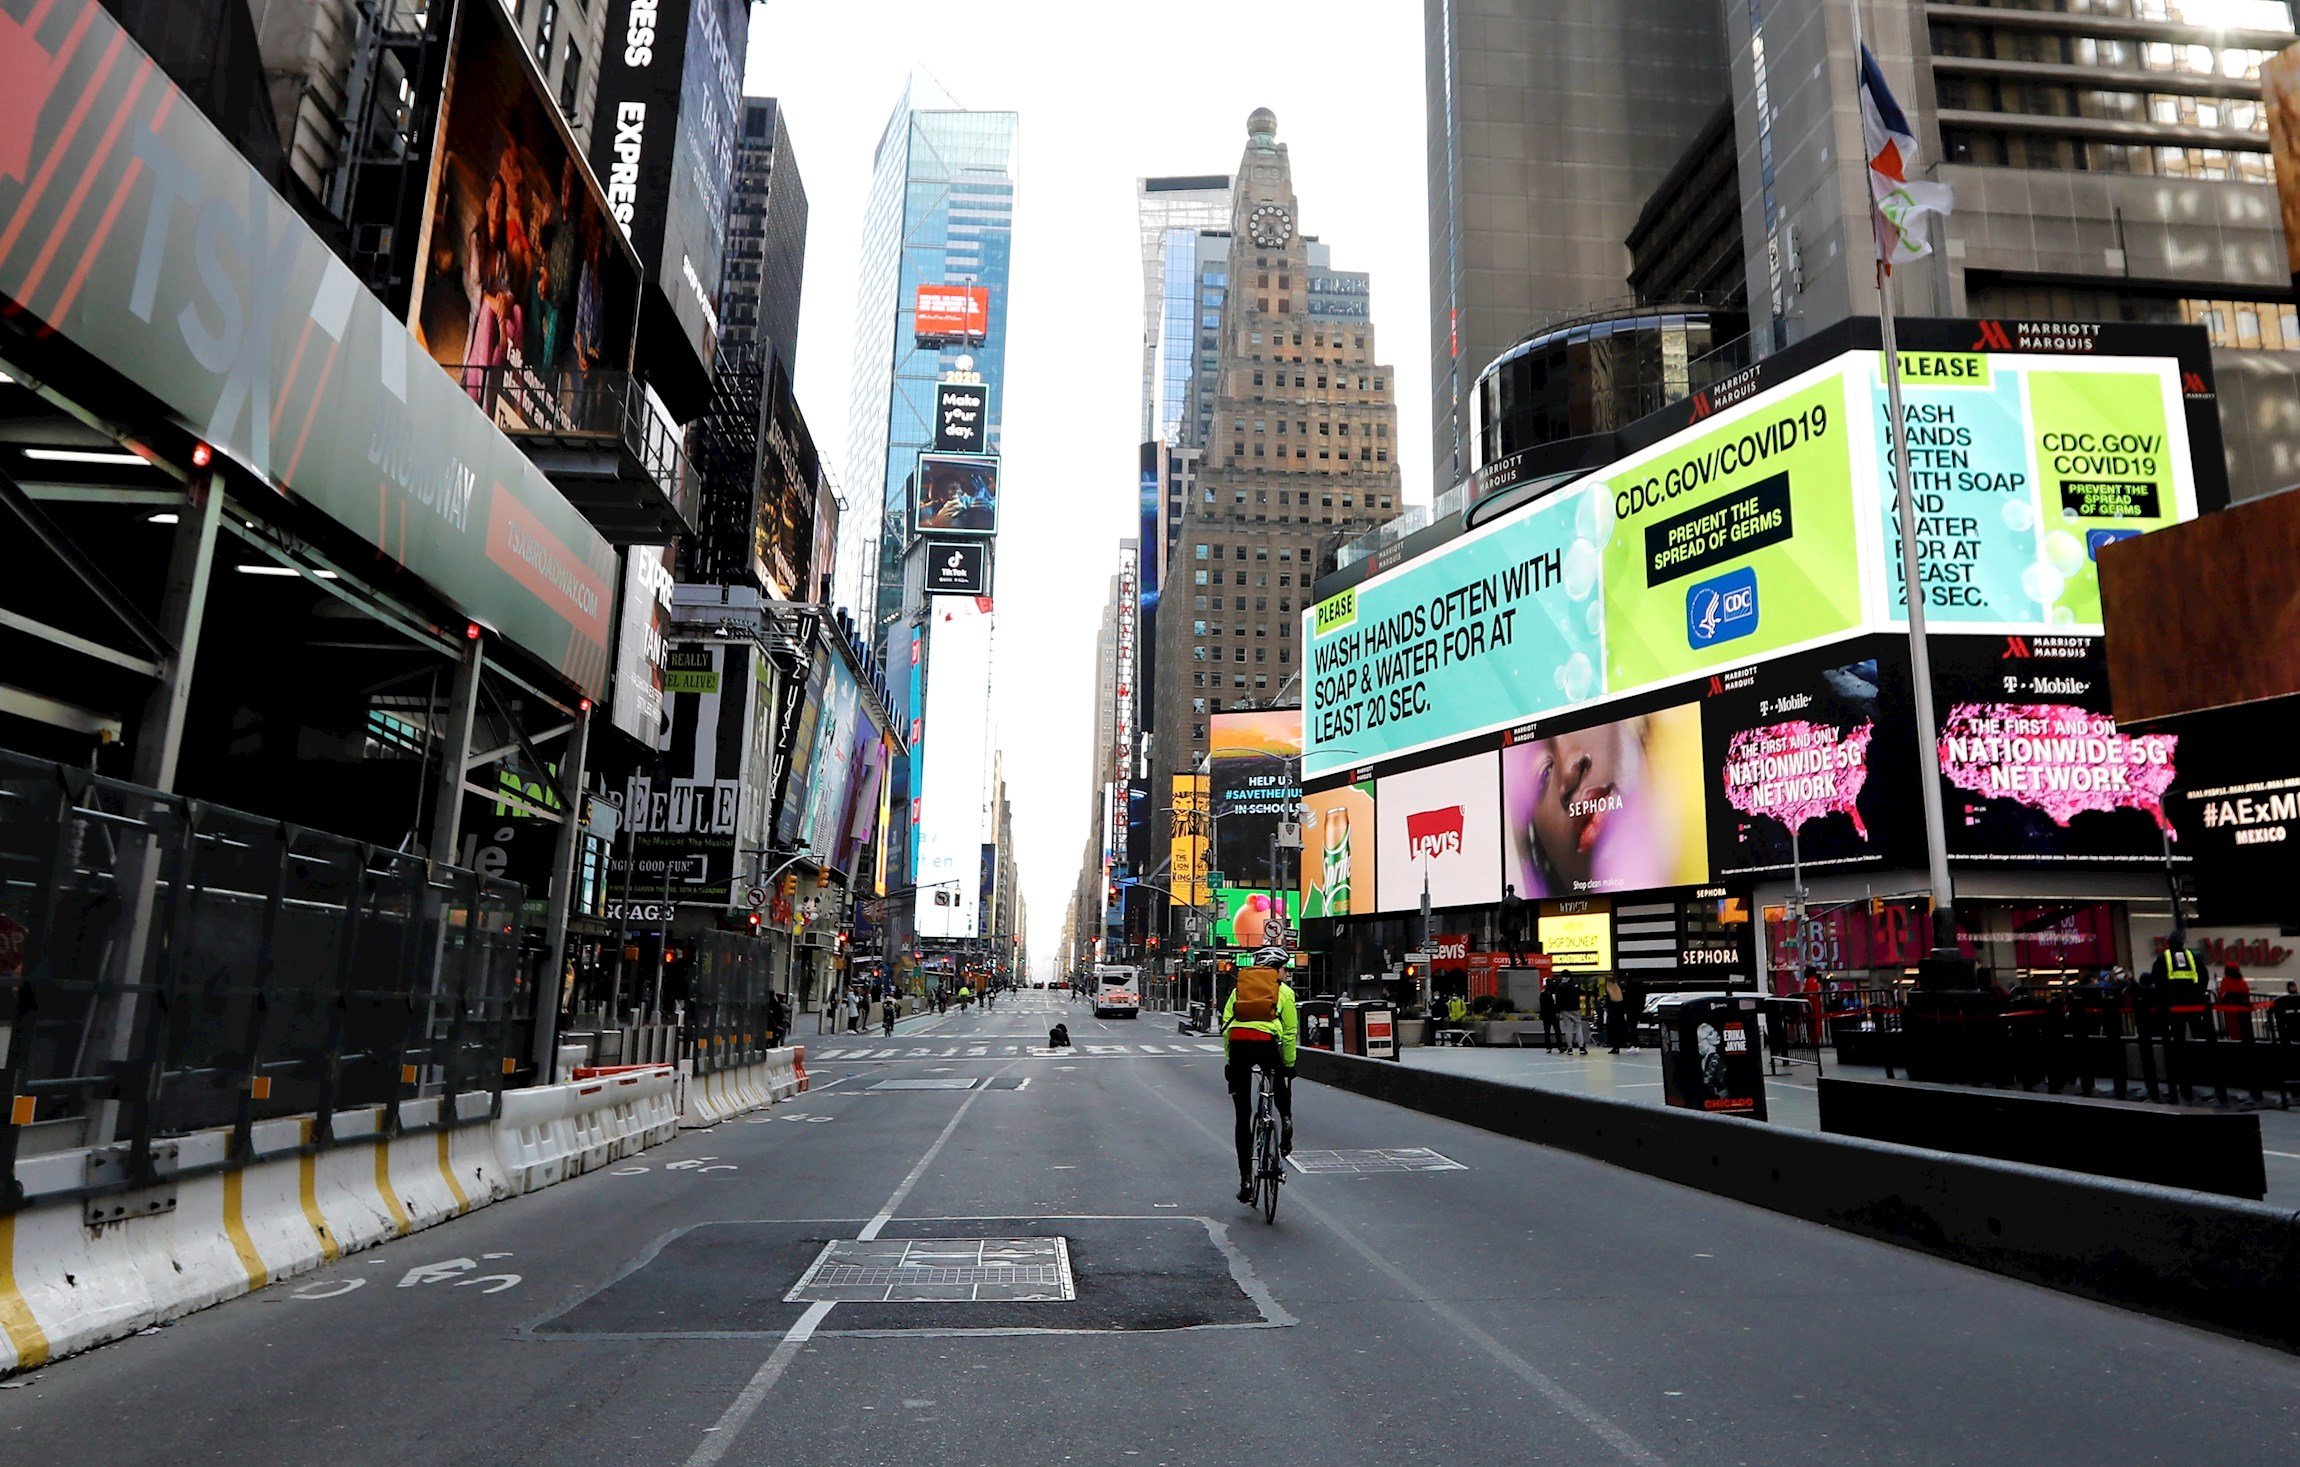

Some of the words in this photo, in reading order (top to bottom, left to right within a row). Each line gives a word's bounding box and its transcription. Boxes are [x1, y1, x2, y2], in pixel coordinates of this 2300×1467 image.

[2018, 323, 2100, 336] MARRIOTT
[2019, 337, 2093, 350] MARQUIS
[1713, 365, 1762, 395] MARRIOTT
[942, 392, 980, 407] Make
[1714, 382, 1757, 409] MARQUIS
[944, 408, 976, 424] your
[945, 423, 974, 440] day.
[2042, 434, 2162, 455] CDC.GOV/
[1479, 454, 1523, 481] MARRIOTT
[1615, 404, 1827, 519] CDC.GOV/COVID19
[2054, 456, 2157, 476] COVID19
[1479, 470, 1517, 494] MARQUIS
[1958, 472, 2025, 492] SOAP
[2068, 484, 2123, 495] PREVENT
[2125, 485, 2148, 495] THE
[2084, 494, 2131, 505] SPREAD
[2080, 504, 2096, 515] OF
[2099, 504, 2141, 515] GERMS
[1668, 509, 1727, 547] PREVENT
[1730, 496, 1759, 521] THE
[1654, 539, 1705, 571] SPREAD
[1708, 531, 1727, 551] OF
[1730, 508, 1782, 540] GERMS
[1952, 541, 1982, 560] AT
[942, 568, 967, 577] TikTok
[1725, 590, 1751, 613] CDC
[1932, 587, 1989, 607] SEC.
[1314, 631, 1360, 675] WASH
[1365, 605, 1426, 652] HANDS
[1430, 575, 1497, 631] OFTEN
[1502, 548, 1562, 603] WITH
[1318, 594, 1352, 626] PLEASE
[2033, 637, 2091, 647] MARRIOTT
[672, 652, 708, 666] REALLY
[1315, 670, 1357, 710] SOAP
[1361, 663, 1372, 694] &
[1376, 638, 1438, 688] WATER
[1444, 621, 1485, 666] FOR
[1490, 608, 1516, 650] AT
[2034, 648, 2087, 658] MARQUIS
[683, 674, 716, 689] ALIVE!
[1725, 666, 1757, 681] MARRIOTT
[1725, 677, 1754, 691] MARQUIS
[1315, 701, 1370, 745] LEAST
[1367, 695, 1386, 729] 20
[1390, 681, 1431, 722] SEC.
[1513, 724, 1537, 735] MARRIOTT
[1968, 719, 2001, 734] THE
[2005, 719, 2050, 735] FIRST
[2055, 720, 2088, 735] AND
[1513, 732, 1535, 743] MARQUIS
[1741, 744, 1758, 759] THE
[1761, 737, 1787, 755] FIRST
[1790, 733, 1810, 749] AND
[1813, 726, 1840, 745] ONLY
[1950, 737, 2125, 763] NATIONWIDE
[2130, 739, 2168, 764] 5G
[1729, 751, 1833, 786] NATIONWIDE
[1837, 742, 1862, 768] 5G
[1248, 776, 1278, 787] HELP
[1990, 766, 2131, 791] NETWORK
[1752, 774, 1838, 807] NETWORK
[1235, 805, 1247, 814] IN
[1569, 795, 1624, 818] SEPHORA
[2235, 825, 2286, 845] MEXICO
[639, 860, 664, 871] GOOD
[1173, 861, 1190, 872] LION
[1172, 871, 1191, 883] KING
[1573, 880, 1586, 890] Shop
[1587, 879, 1601, 889] clean
[1696, 888, 1726, 899] SEPHORA
[1683, 949, 1739, 965] SEPHORA
[1724, 1029, 1745, 1041] ERIKA
[1725, 1041, 1747, 1052] JAYNE
[1704, 1098, 1754, 1109] CHICAGO
